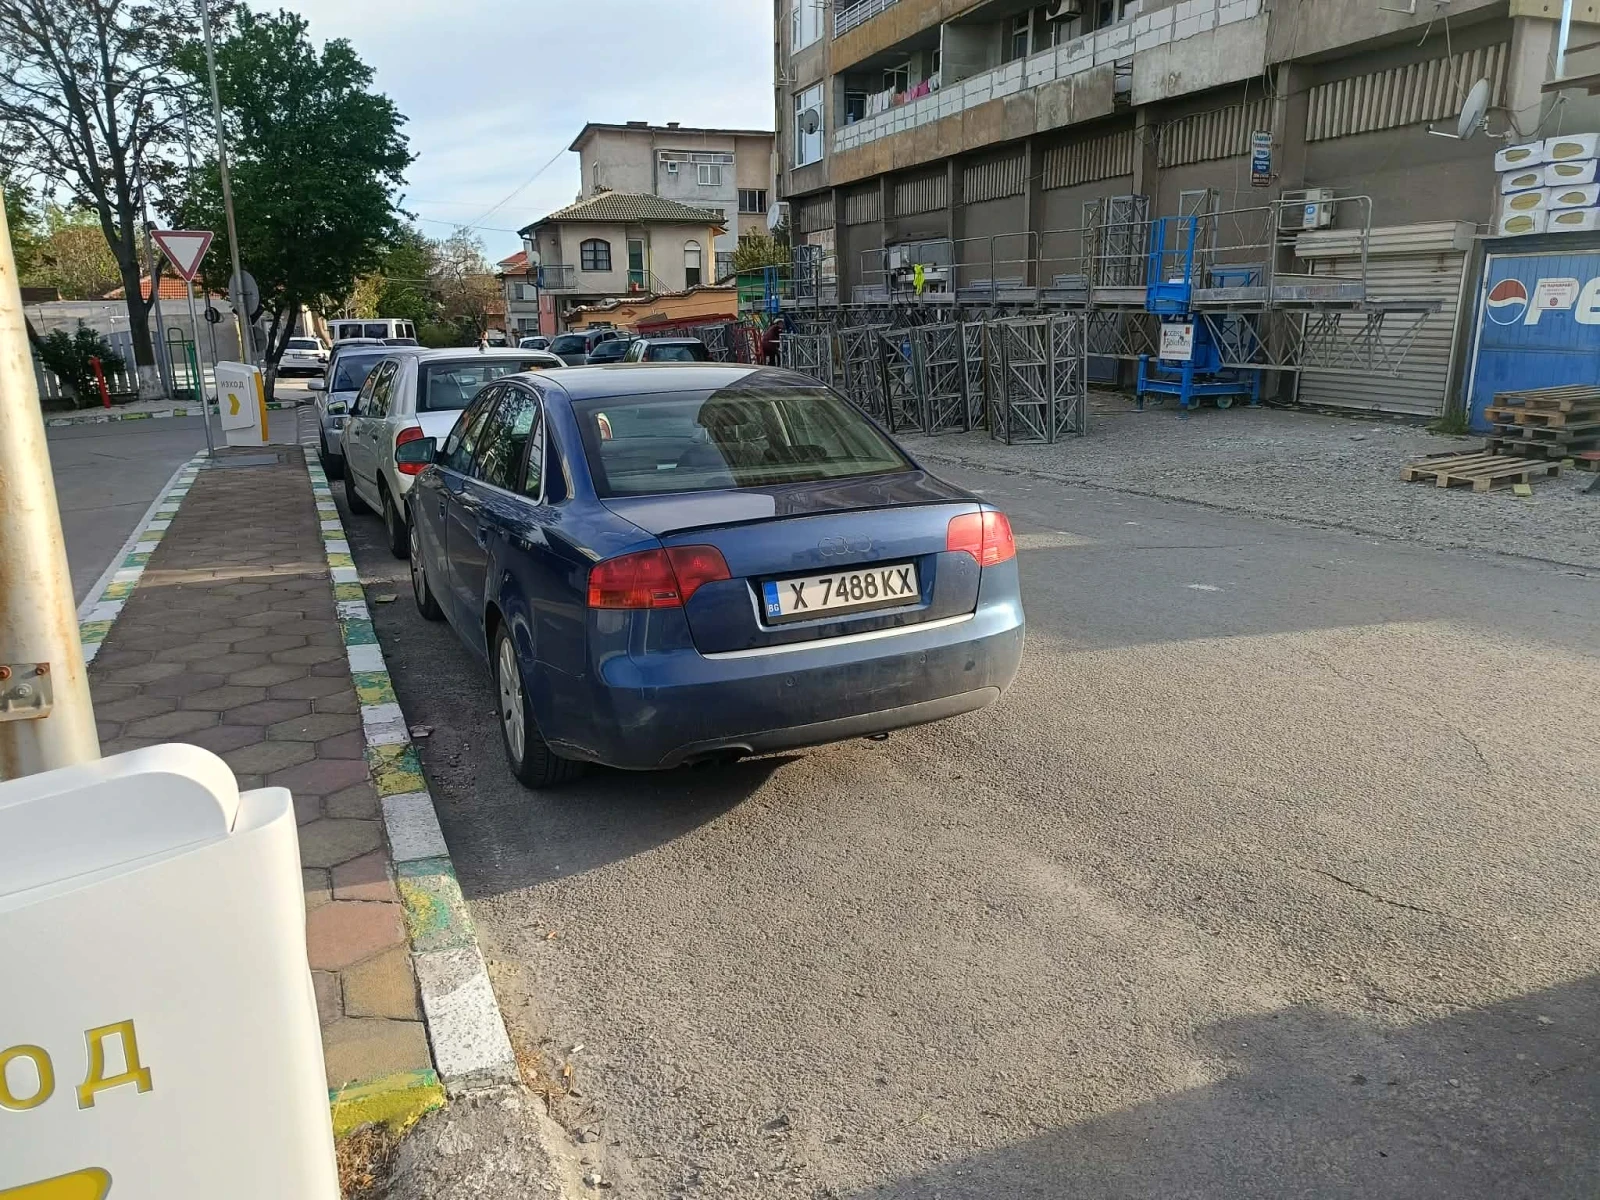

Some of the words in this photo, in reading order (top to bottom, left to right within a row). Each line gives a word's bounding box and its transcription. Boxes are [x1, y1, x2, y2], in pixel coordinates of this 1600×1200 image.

[220, 380, 245, 389] ИЗХОД
[790, 581, 809, 610] X
[768, 603, 780, 613] BG
